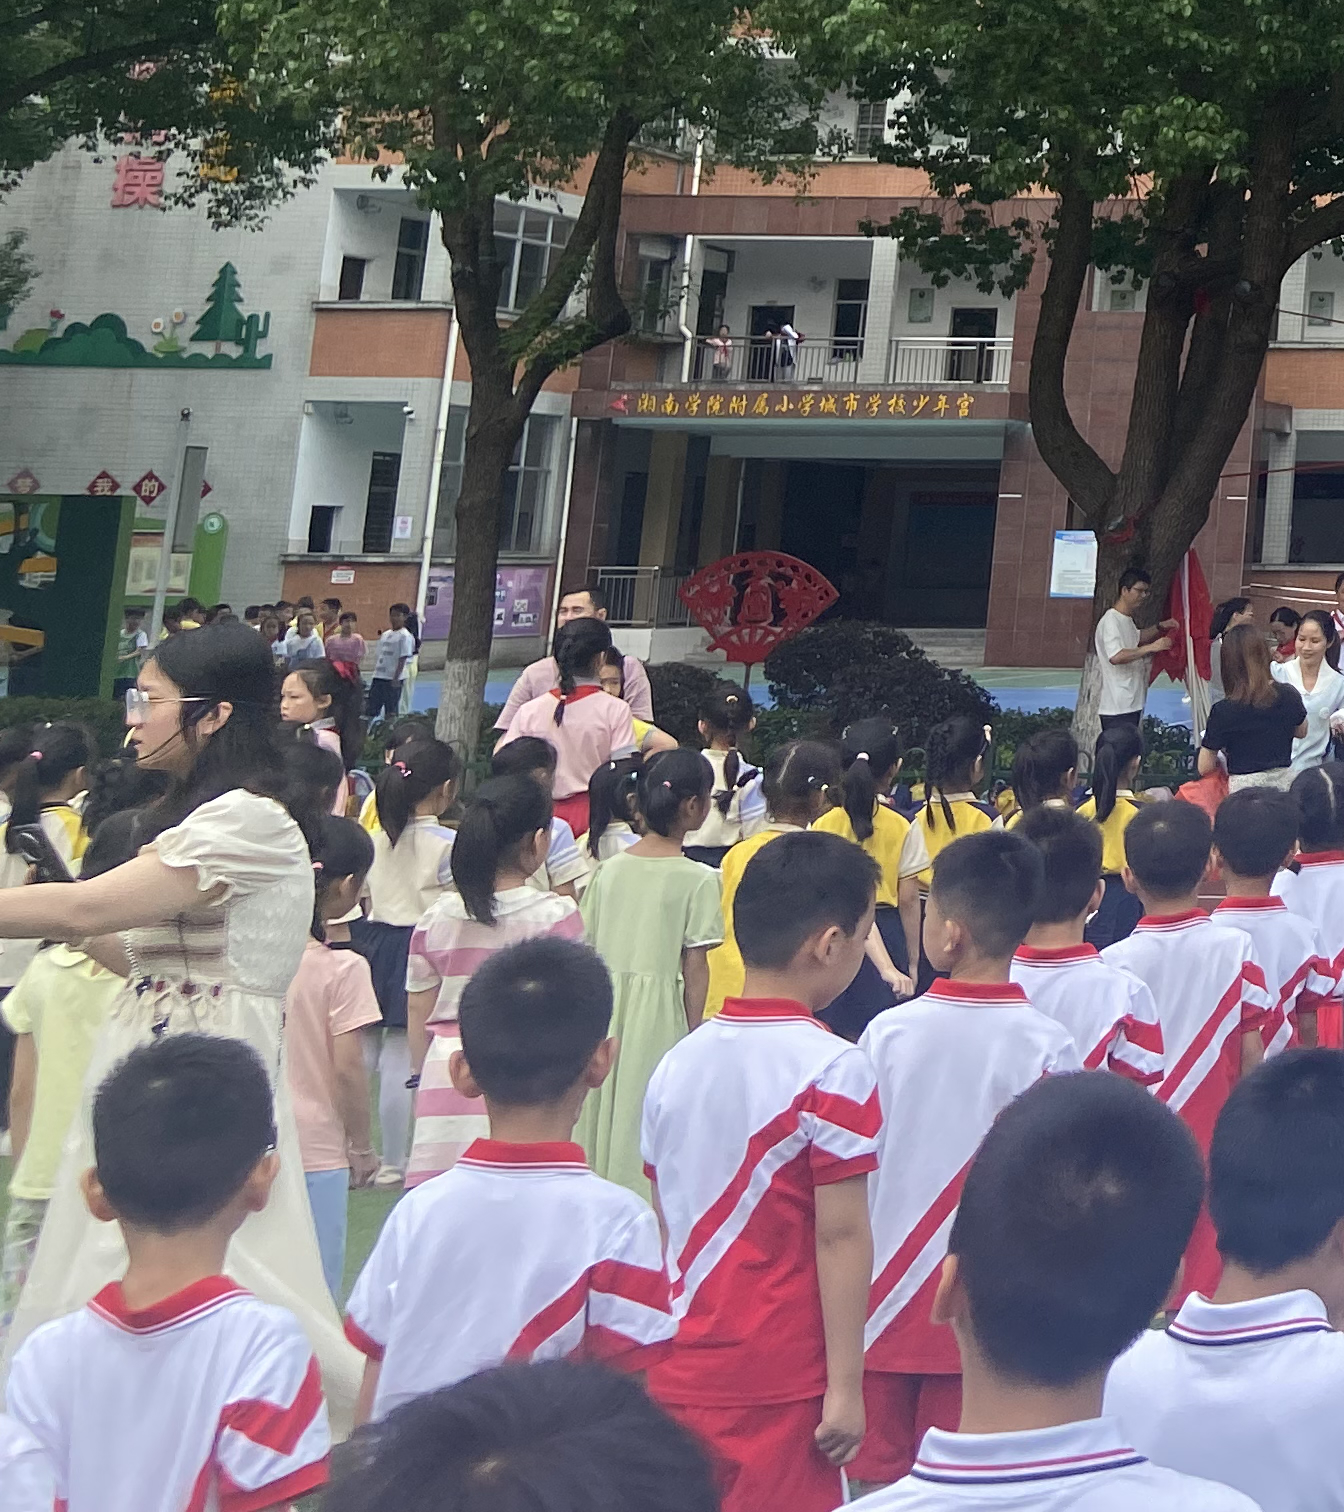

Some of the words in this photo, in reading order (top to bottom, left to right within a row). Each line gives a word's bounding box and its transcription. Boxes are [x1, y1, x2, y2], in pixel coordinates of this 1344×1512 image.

[636, 392, 977, 419] 湘南学院附属小学城市学校少年宫
